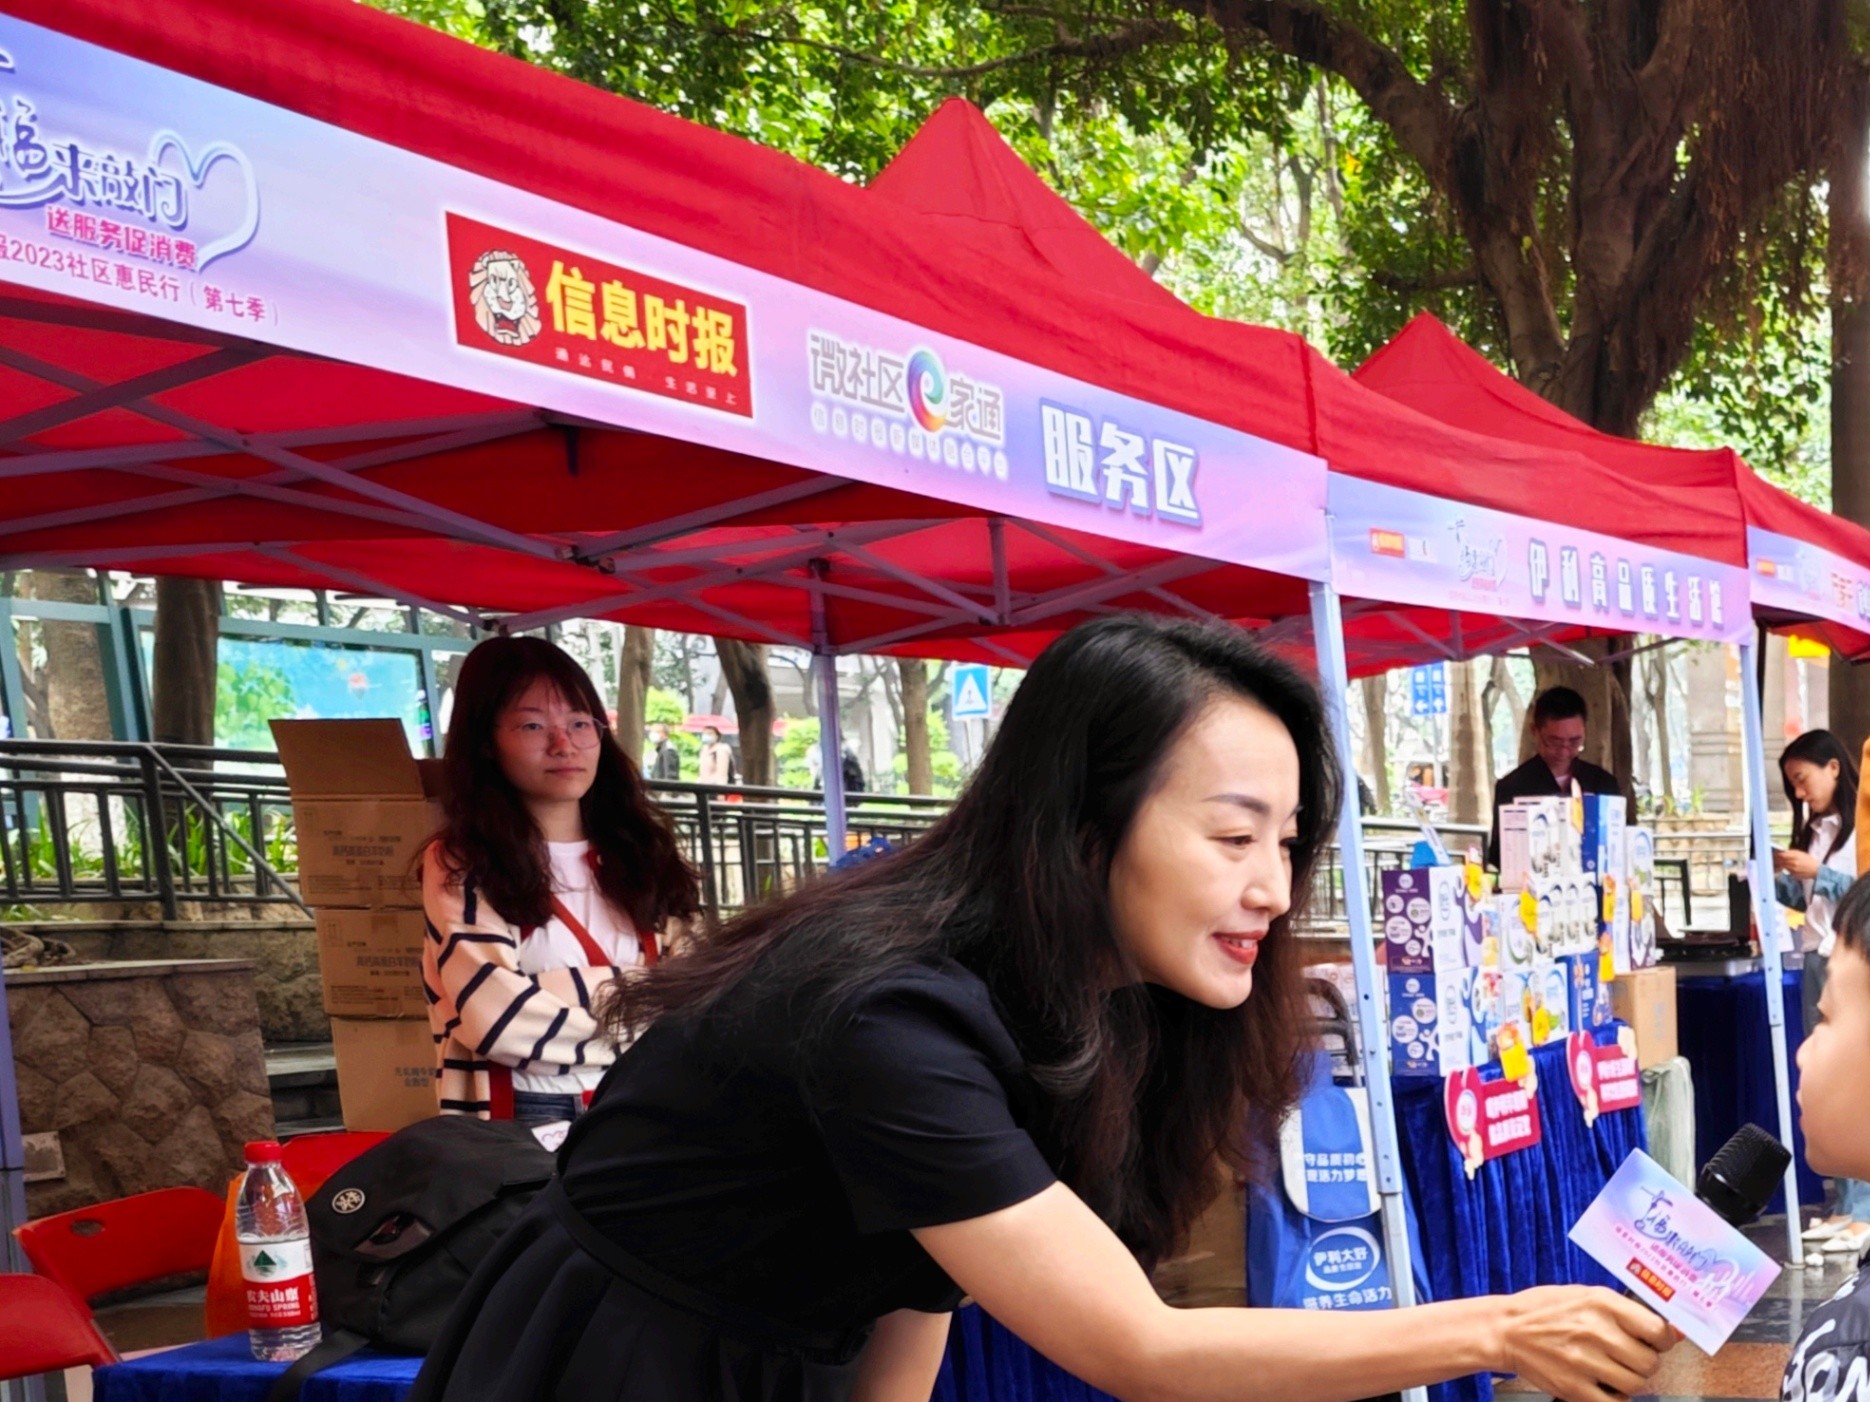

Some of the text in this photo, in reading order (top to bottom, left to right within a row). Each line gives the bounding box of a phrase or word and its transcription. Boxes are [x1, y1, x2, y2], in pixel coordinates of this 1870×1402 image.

[48, 206, 197, 273] 送服务促消费
[546, 260, 738, 378] 信息时报
[1041, 400, 1200, 524] 服务区
[1528, 538, 1724, 629] 伊利高品质生活馆
